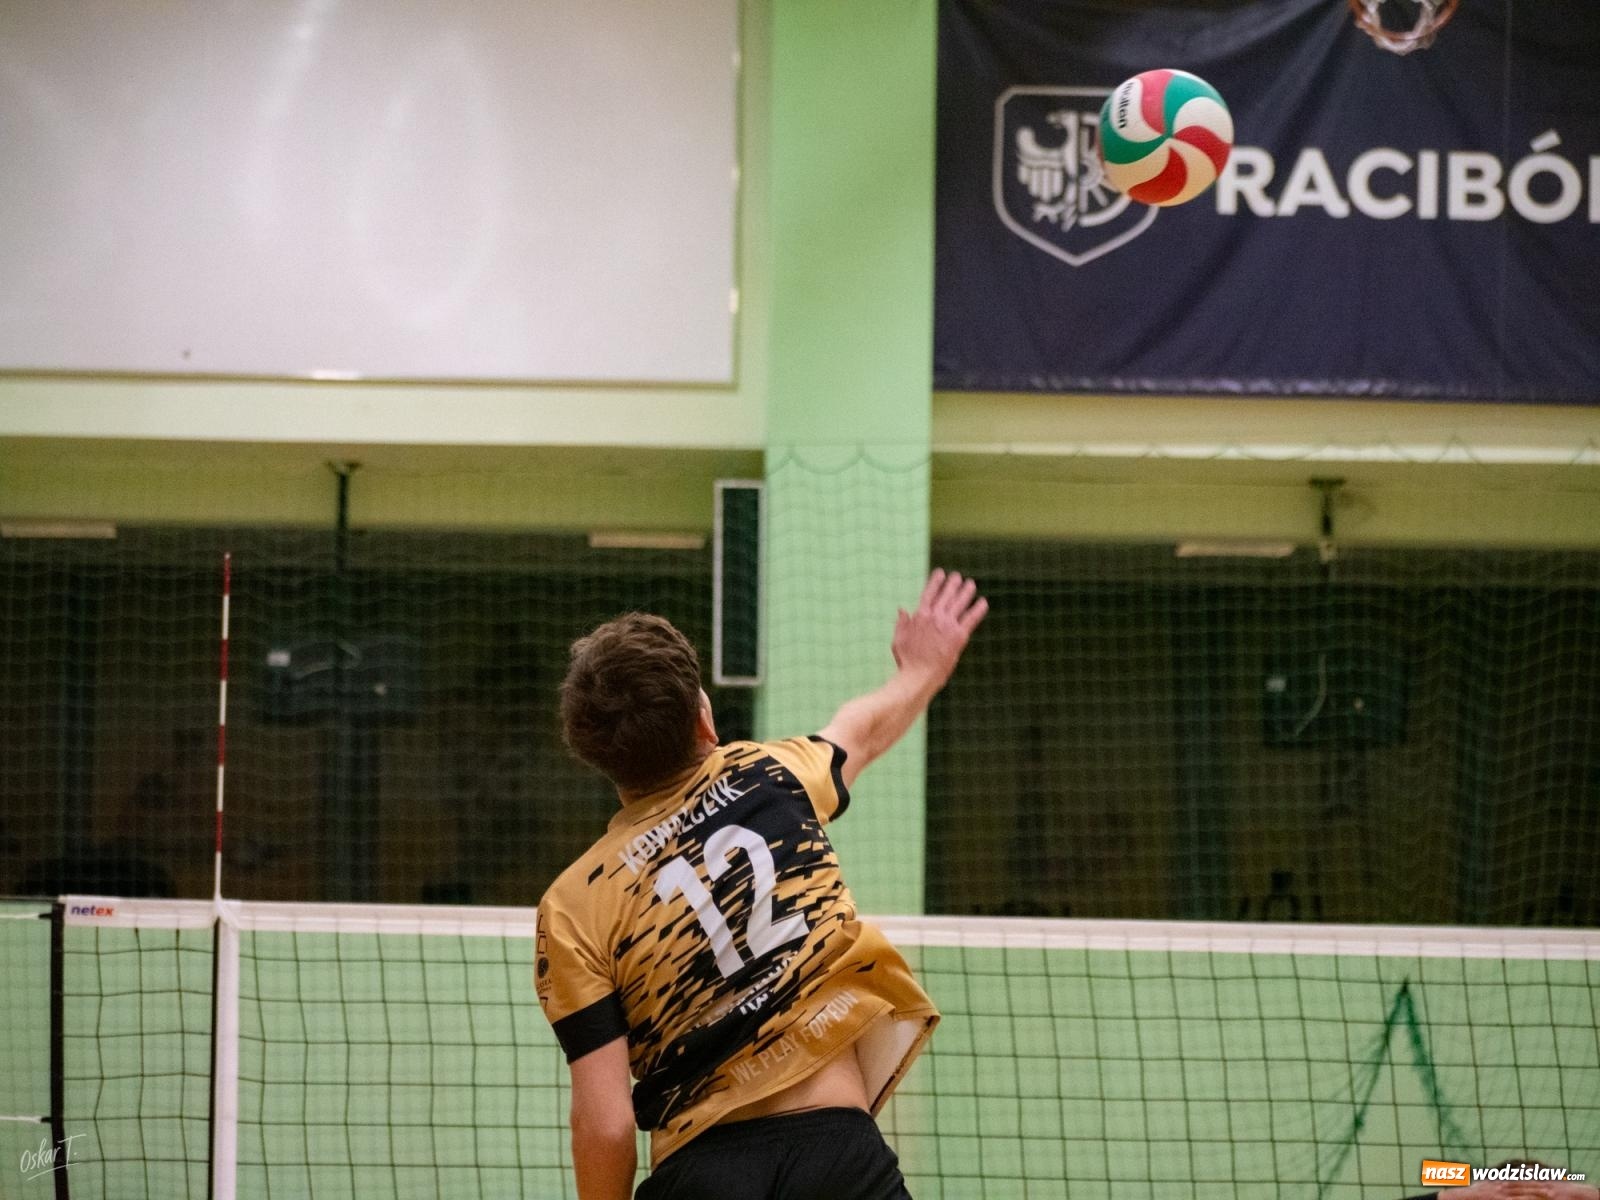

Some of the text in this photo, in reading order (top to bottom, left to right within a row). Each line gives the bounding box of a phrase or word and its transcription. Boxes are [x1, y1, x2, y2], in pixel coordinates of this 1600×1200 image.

[1215, 129, 1600, 224] RACIBÓ
[70, 904, 114, 917] netex
[653, 824, 810, 979] 12
[729, 1059, 762, 1086] WE
[757, 1032, 800, 1070] PLAY
